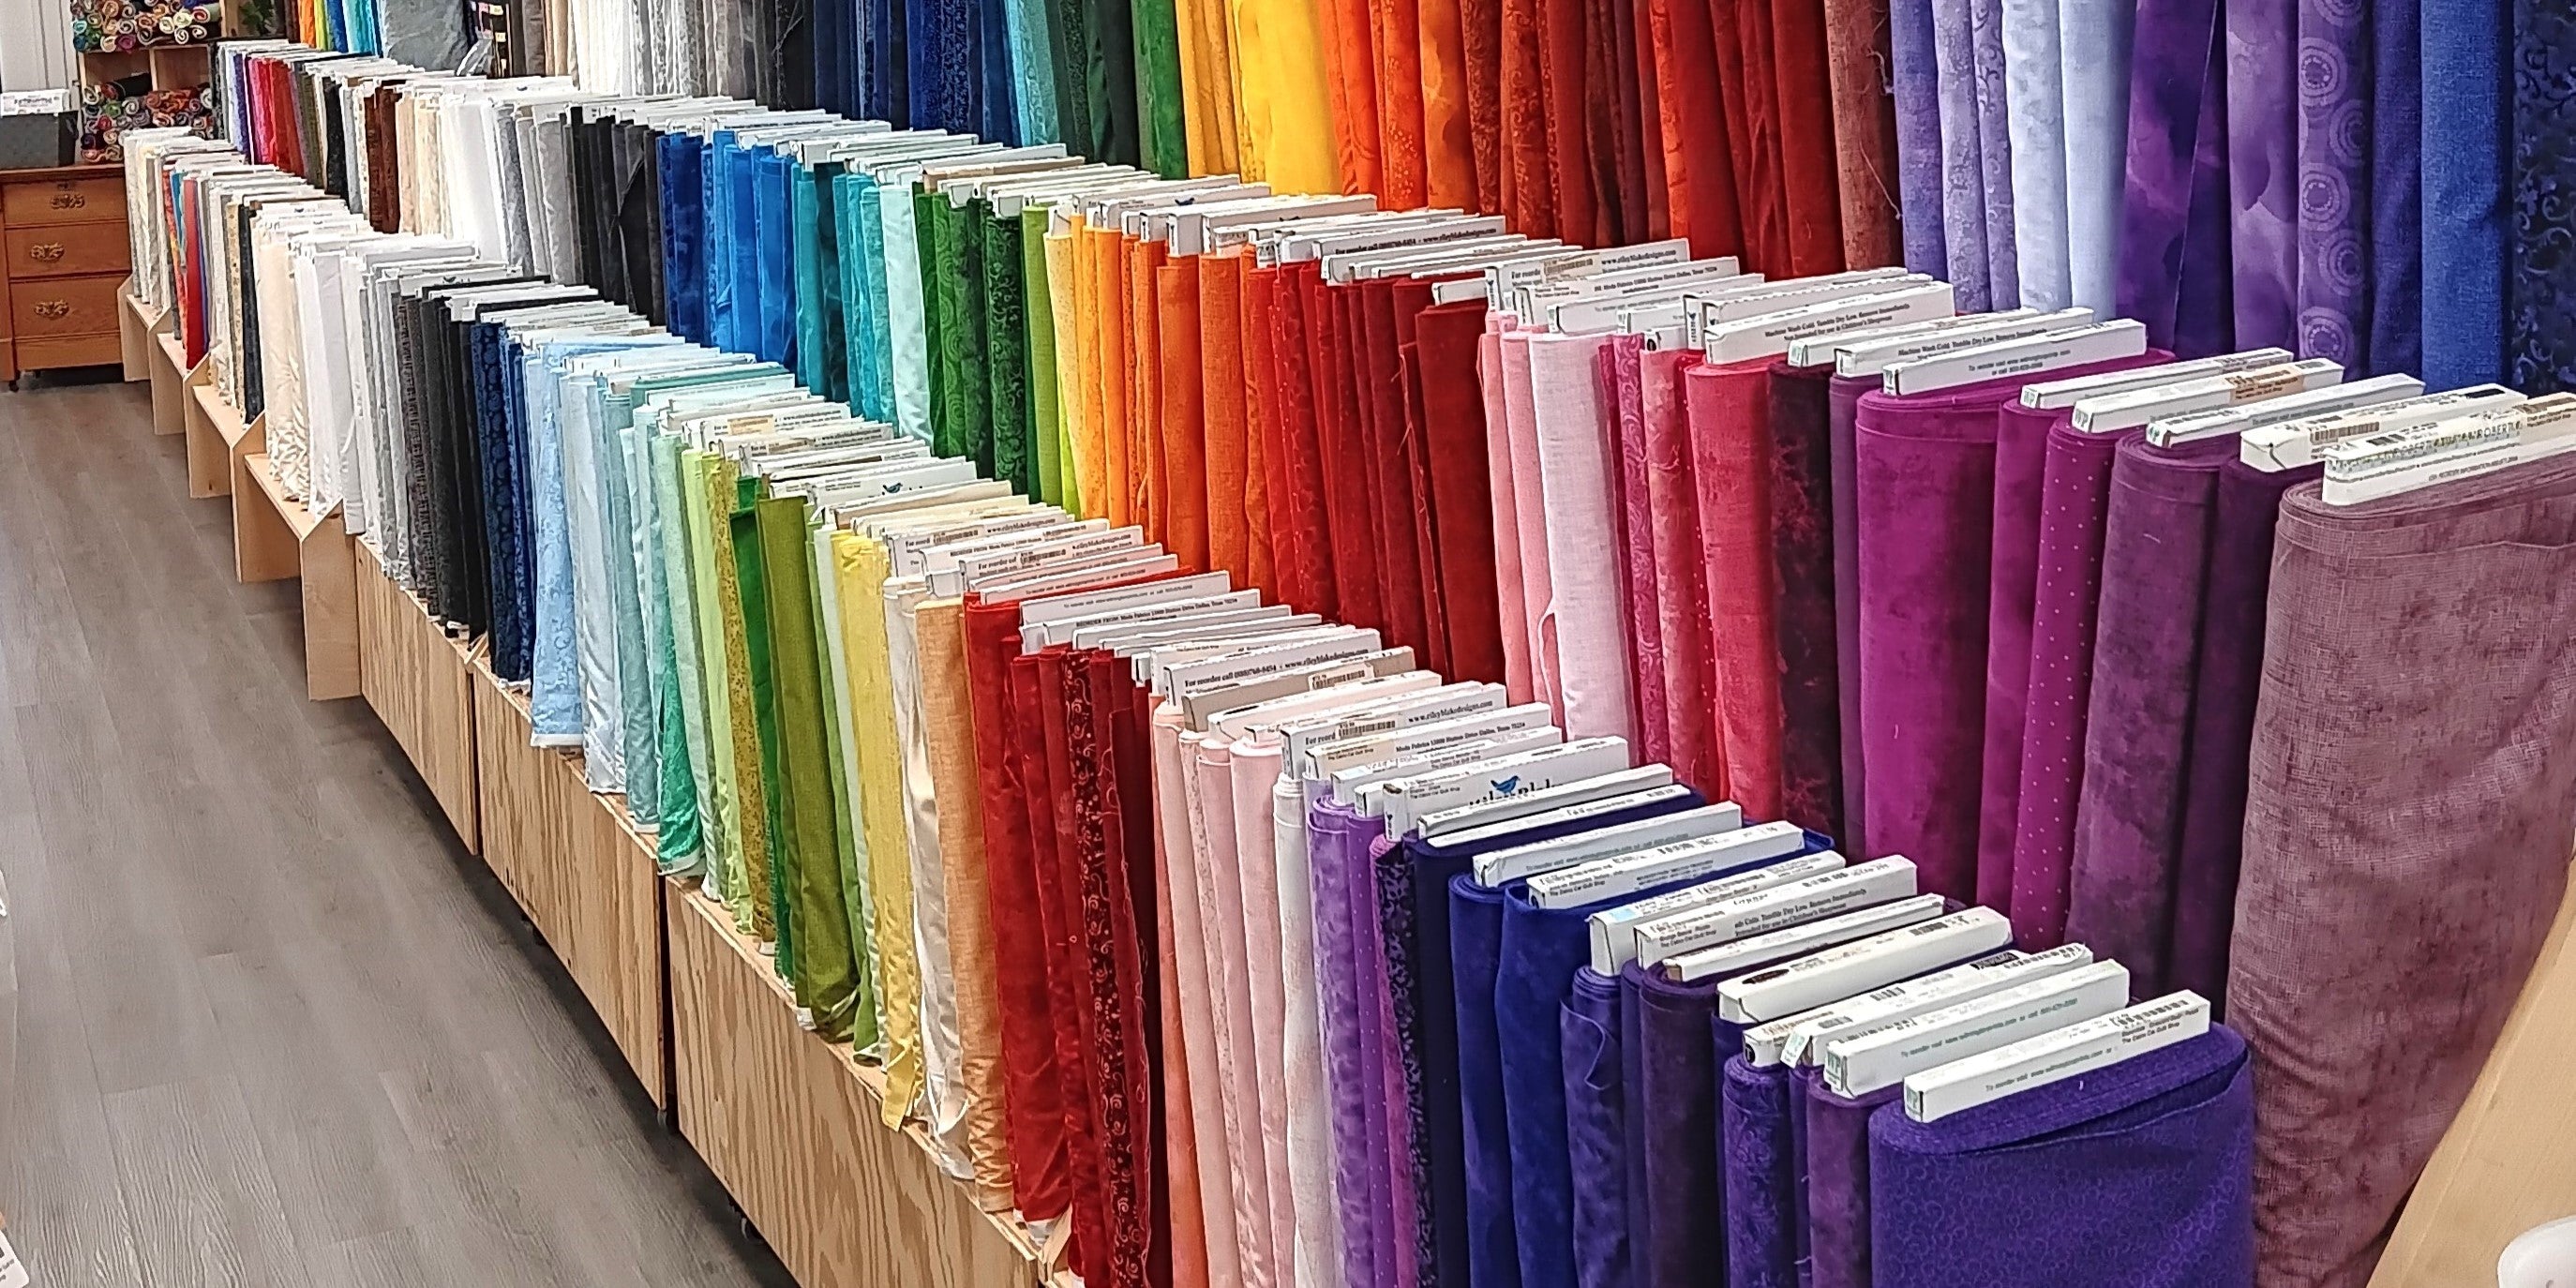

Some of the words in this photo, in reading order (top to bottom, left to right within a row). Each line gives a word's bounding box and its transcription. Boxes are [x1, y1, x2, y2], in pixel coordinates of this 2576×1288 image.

[1185, 680, 1196, 688] For
[1197, 675, 1221, 685] reorder
[1222, 672, 1234, 681] call
[1306, 735, 1317, 746] For
